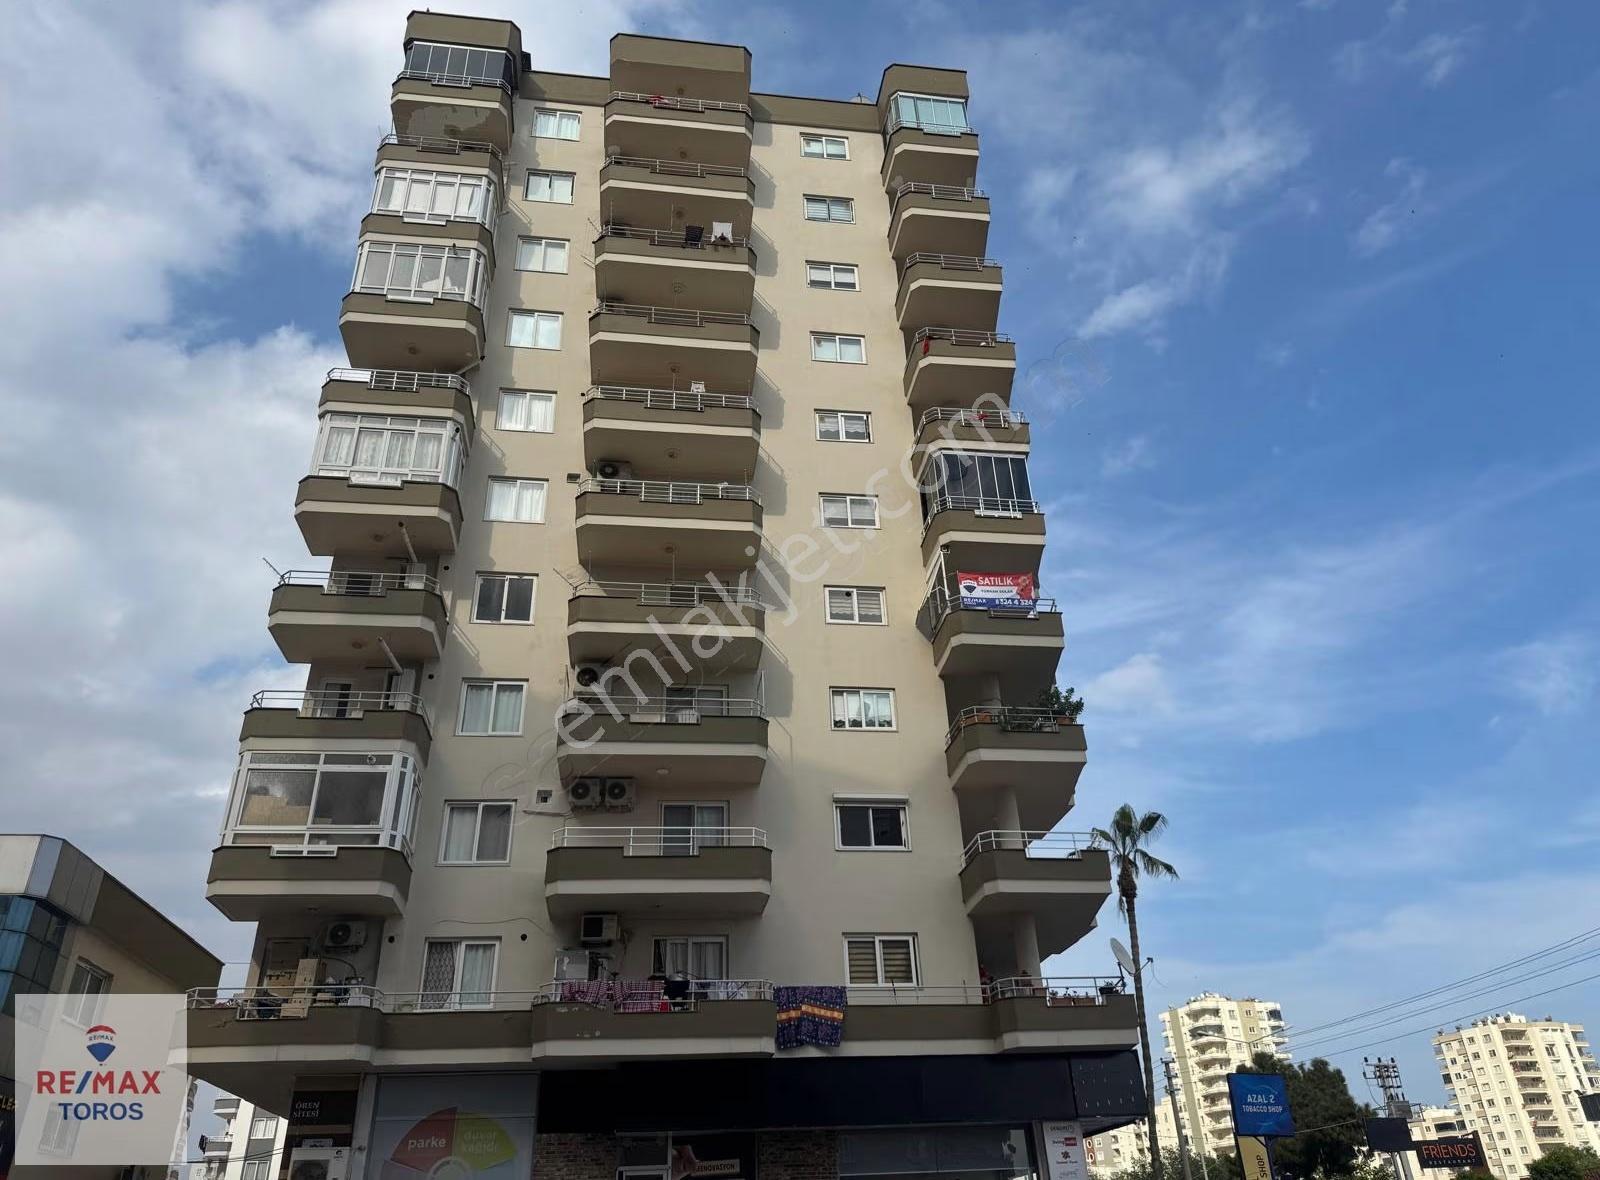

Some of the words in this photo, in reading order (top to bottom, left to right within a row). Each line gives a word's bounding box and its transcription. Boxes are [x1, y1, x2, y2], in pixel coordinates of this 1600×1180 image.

[978, 576, 1013, 585] SATILIK
[1247, 1094, 1268, 1104] AZAL
[1269, 1095, 1276, 1104] 2
[1242, 1105, 1268, 1113] TOBACCO
[1268, 1105, 1283, 1113] SHOP
[407, 1136, 448, 1151] parke
[1256, 1154, 1268, 1179] SHOP
